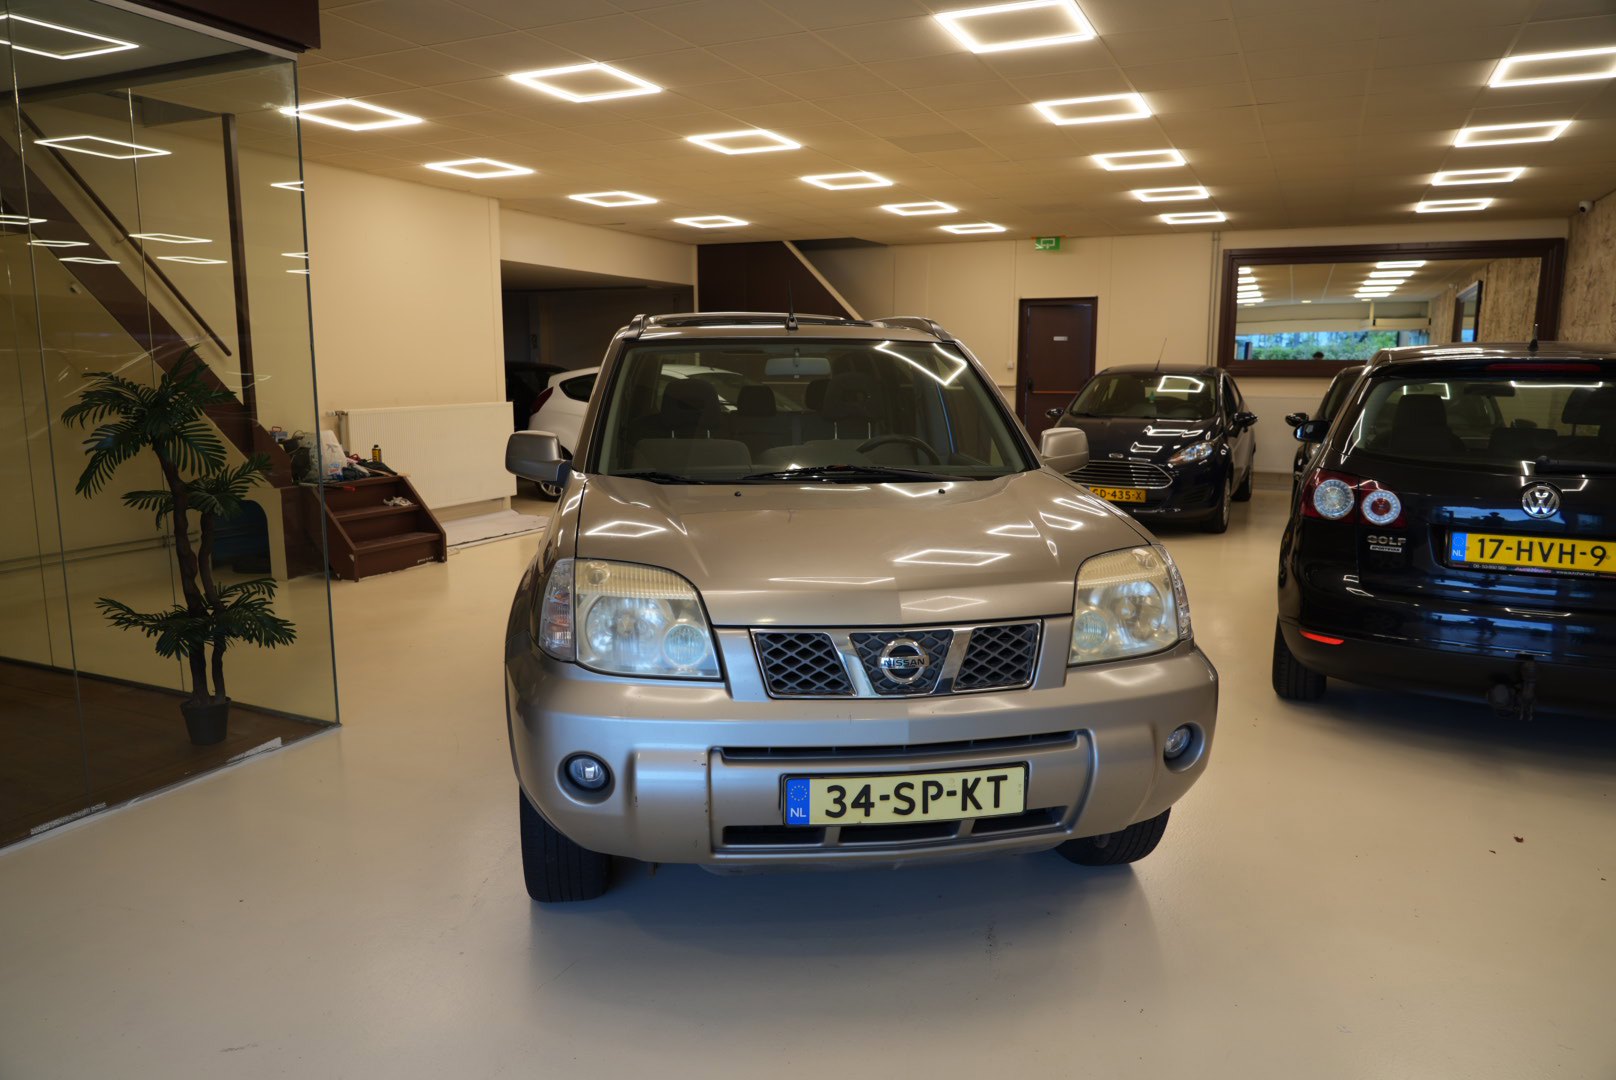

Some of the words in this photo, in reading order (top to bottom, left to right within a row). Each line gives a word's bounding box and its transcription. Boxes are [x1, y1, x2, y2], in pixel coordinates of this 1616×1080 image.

[1367, 534, 1407, 546] GOLF
[1452, 549, 1464, 557] NL
[1478, 538, 1607, 567] 17-HVH-9
[883, 657, 925, 668] NISSAN
[824, 774, 1008, 819] 34-SP-KT
[790, 807, 807, 818] NL
